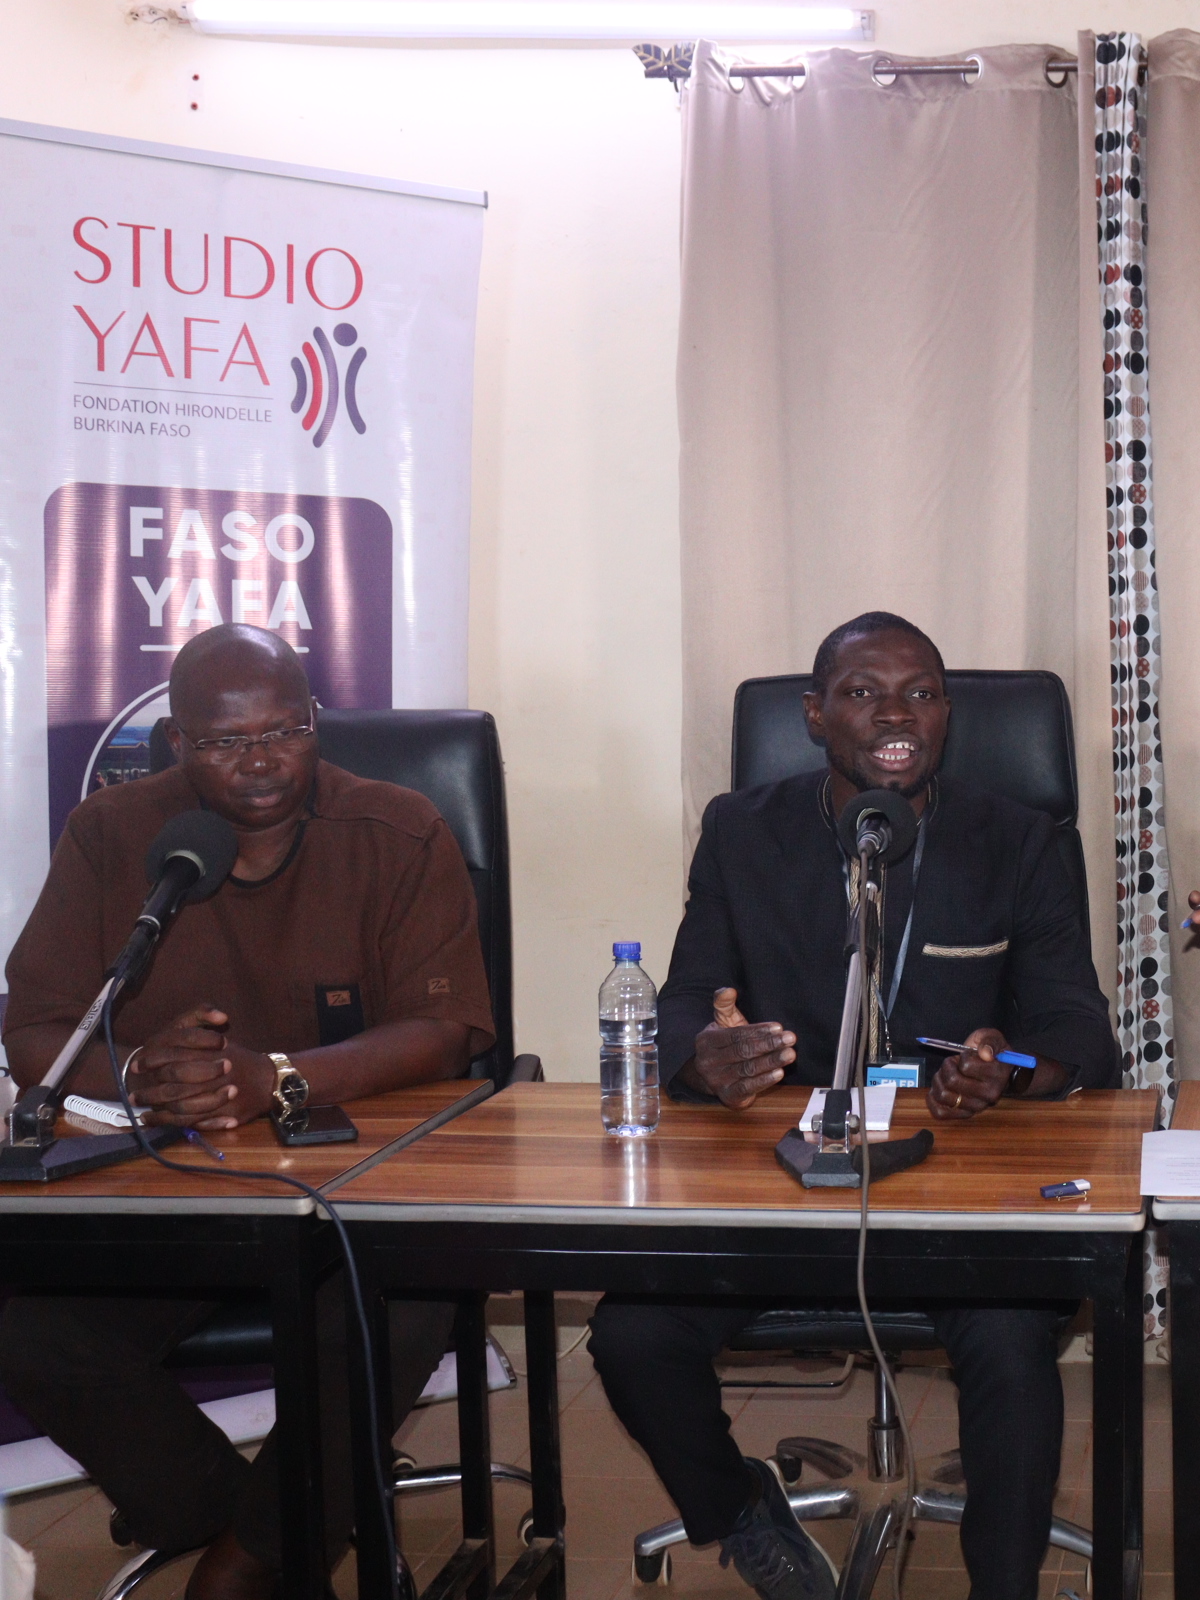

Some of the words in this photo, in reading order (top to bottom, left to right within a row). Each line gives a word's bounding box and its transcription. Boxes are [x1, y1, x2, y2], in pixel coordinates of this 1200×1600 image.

[73, 217, 363, 310] STUDIO
[73, 305, 270, 386] YAFA
[73, 394, 170, 415] FONDATION
[175, 403, 273, 423] HIRONDELLE
[73, 416, 145, 435] BURKINA
[150, 422, 191, 438] FASO
[129, 506, 315, 563] FASO
[131, 576, 313, 630] YAFA
